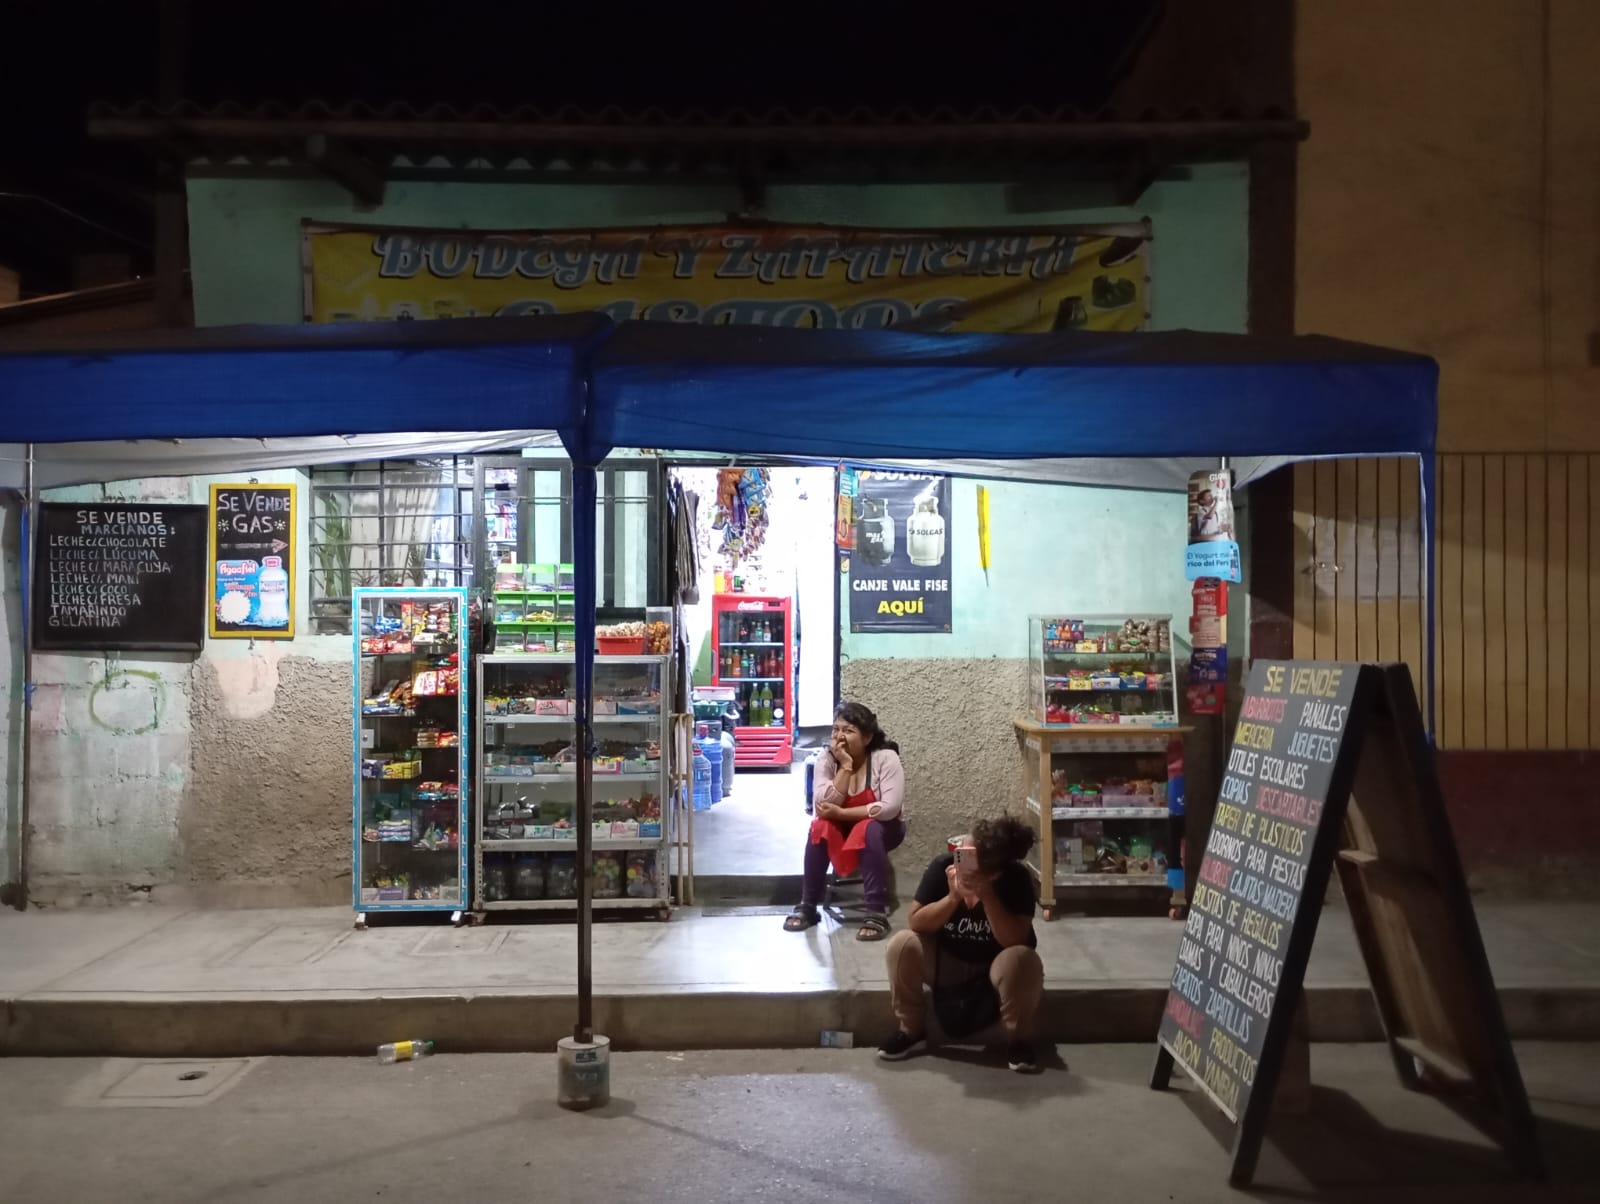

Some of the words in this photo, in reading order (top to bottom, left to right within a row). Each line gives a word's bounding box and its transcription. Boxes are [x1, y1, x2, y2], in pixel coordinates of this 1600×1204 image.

[656, 236, 709, 280] Y
[217, 493, 240, 512] SE
[242, 491, 290, 512] VENDE
[76, 510, 98, 524] SE
[104, 511, 162, 525] VENDE
[232, 514, 274, 533] GAS
[50, 535, 84, 547] LECHE
[98, 537, 167, 548] CHOCOLATE
[50, 548, 85, 561] LECHE
[103, 547, 159, 561] LÚCUMA
[50, 561, 86, 573] LECHE
[1187, 560, 1202, 568] rico
[1204, 558, 1215, 567] del
[51, 573, 89, 584] LECHE
[51, 584, 85, 595] LECHE
[100, 584, 128, 595] COCO
[853, 579, 888, 592] CANJE
[892, 579, 920, 592] VALE
[925, 579, 948, 592] FISE
[51, 594, 85, 605] LECHE
[100, 593, 142, 605] FRESA
[51, 604, 127, 617] TAMARINDO
[877, 596, 925, 616] AQUÍ
[1264, 665, 1286, 693] SE
[1289, 666, 1344, 699] VENDE
[1288, 731, 1338, 764] JUGUETES
[1228, 748, 1259, 778] UTILES
[1259, 755, 1309, 790] ESCOLARES
[1221, 775, 1252, 805] COPIAS
[1215, 801, 1242, 833] TAPER
[1241, 811, 1256, 838] DE
[1257, 817, 1307, 857] PLASTICOS
[1206, 828, 1246, 864] ADORNOS
[1244, 844, 1268, 875] PARA
[1269, 854, 1308, 891] FIESTAS
[1229, 869, 1265, 905] CAJITAS
[1261, 883, 1300, 925] MADERA
[1192, 882, 1227, 919] BOLSITAS
[1226, 900, 1241, 927] DE
[1240, 907, 1283, 951] REGALOS
[1185, 909, 1205, 941] ROPA
[1204, 920, 1225, 955] PARA
[1179, 936, 1205, 972] DAMAS
[1208, 953, 1217, 981] Y
[1219, 962, 1275, 1020] CABALLEROS
[1172, 963, 1204, 1006] ZAPATOS
[1205, 986, 1254, 1044] ZAPATILLAS
[1173, 1030, 1202, 1070] AVON
[1208, 1026, 1258, 1087] PRODUCTOS
